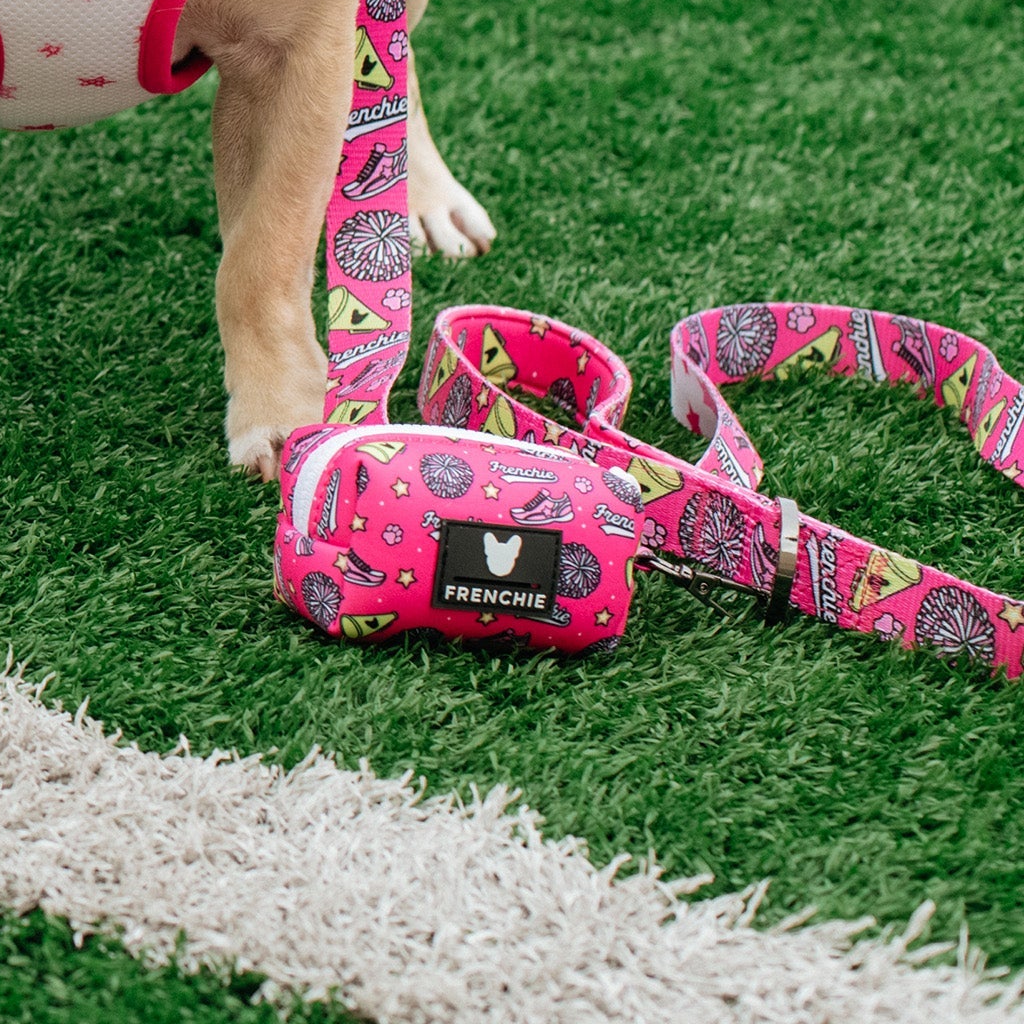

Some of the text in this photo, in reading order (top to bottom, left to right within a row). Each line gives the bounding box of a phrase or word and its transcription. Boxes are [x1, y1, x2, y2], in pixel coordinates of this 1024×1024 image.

[328, 331, 409, 362] renchie
[489, 460, 555, 480] Frenchie
[444, 585, 547, 609] FRENCHIE
